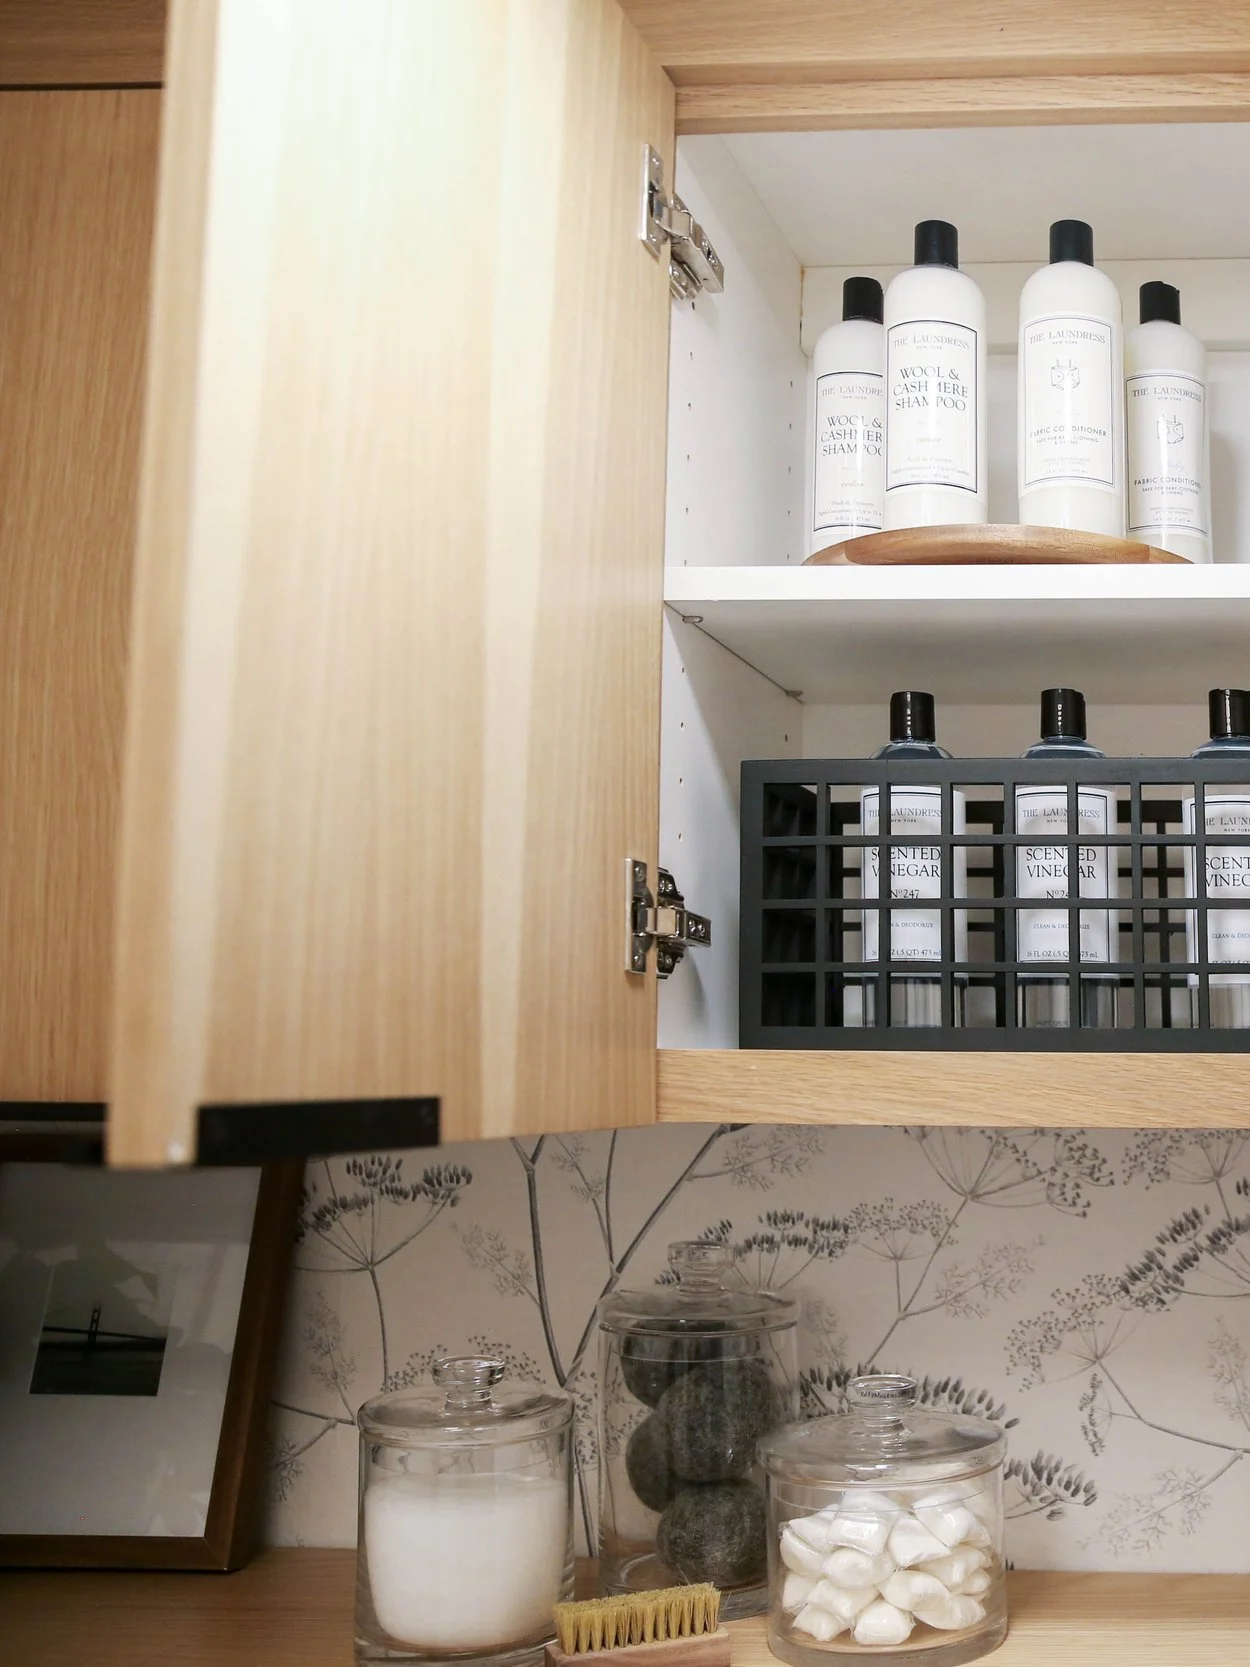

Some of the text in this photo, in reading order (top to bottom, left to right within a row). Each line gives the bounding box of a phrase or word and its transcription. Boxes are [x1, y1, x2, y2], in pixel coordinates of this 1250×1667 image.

[913, 334, 970, 349] LAUNDRESS
[1049, 330, 1106, 344] LAUNDRESS
[900, 366, 961, 381] WOOL &
[840, 386, 884, 398] LAUNDRE
[1053, 425, 1107, 438] CODITIONER
[1022, 808, 1100, 819] THE LAUNRESS
[872, 848, 941, 861] SENTED
[872, 864, 940, 878] VNEGAR
